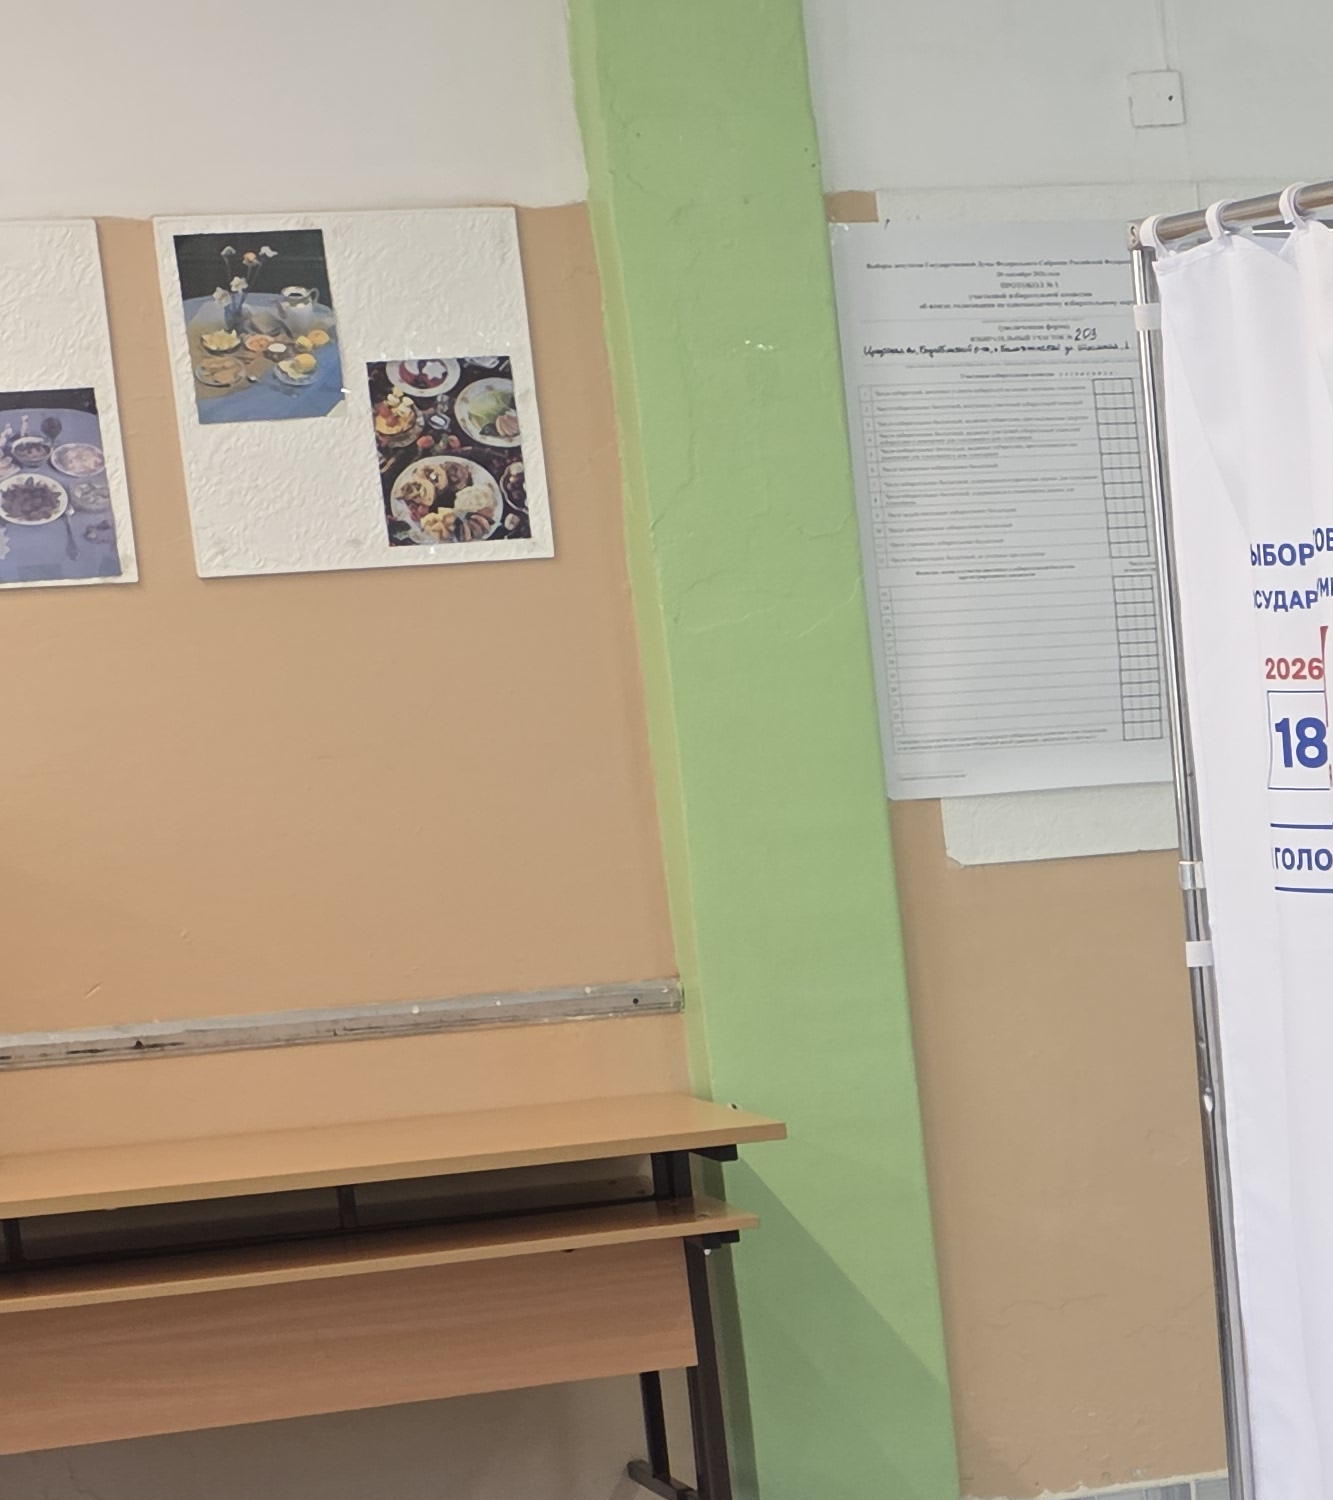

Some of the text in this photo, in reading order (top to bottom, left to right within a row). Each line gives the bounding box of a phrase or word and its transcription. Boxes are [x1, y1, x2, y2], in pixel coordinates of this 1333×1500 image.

[1250, 543, 1314, 566] ЫБОР
[1253, 589, 1318, 612] СУДАР
[1265, 657, 1324, 680] 2026
[1275, 717, 1328, 768] 18
[1272, 846, 1333, 871] ГОЛО
